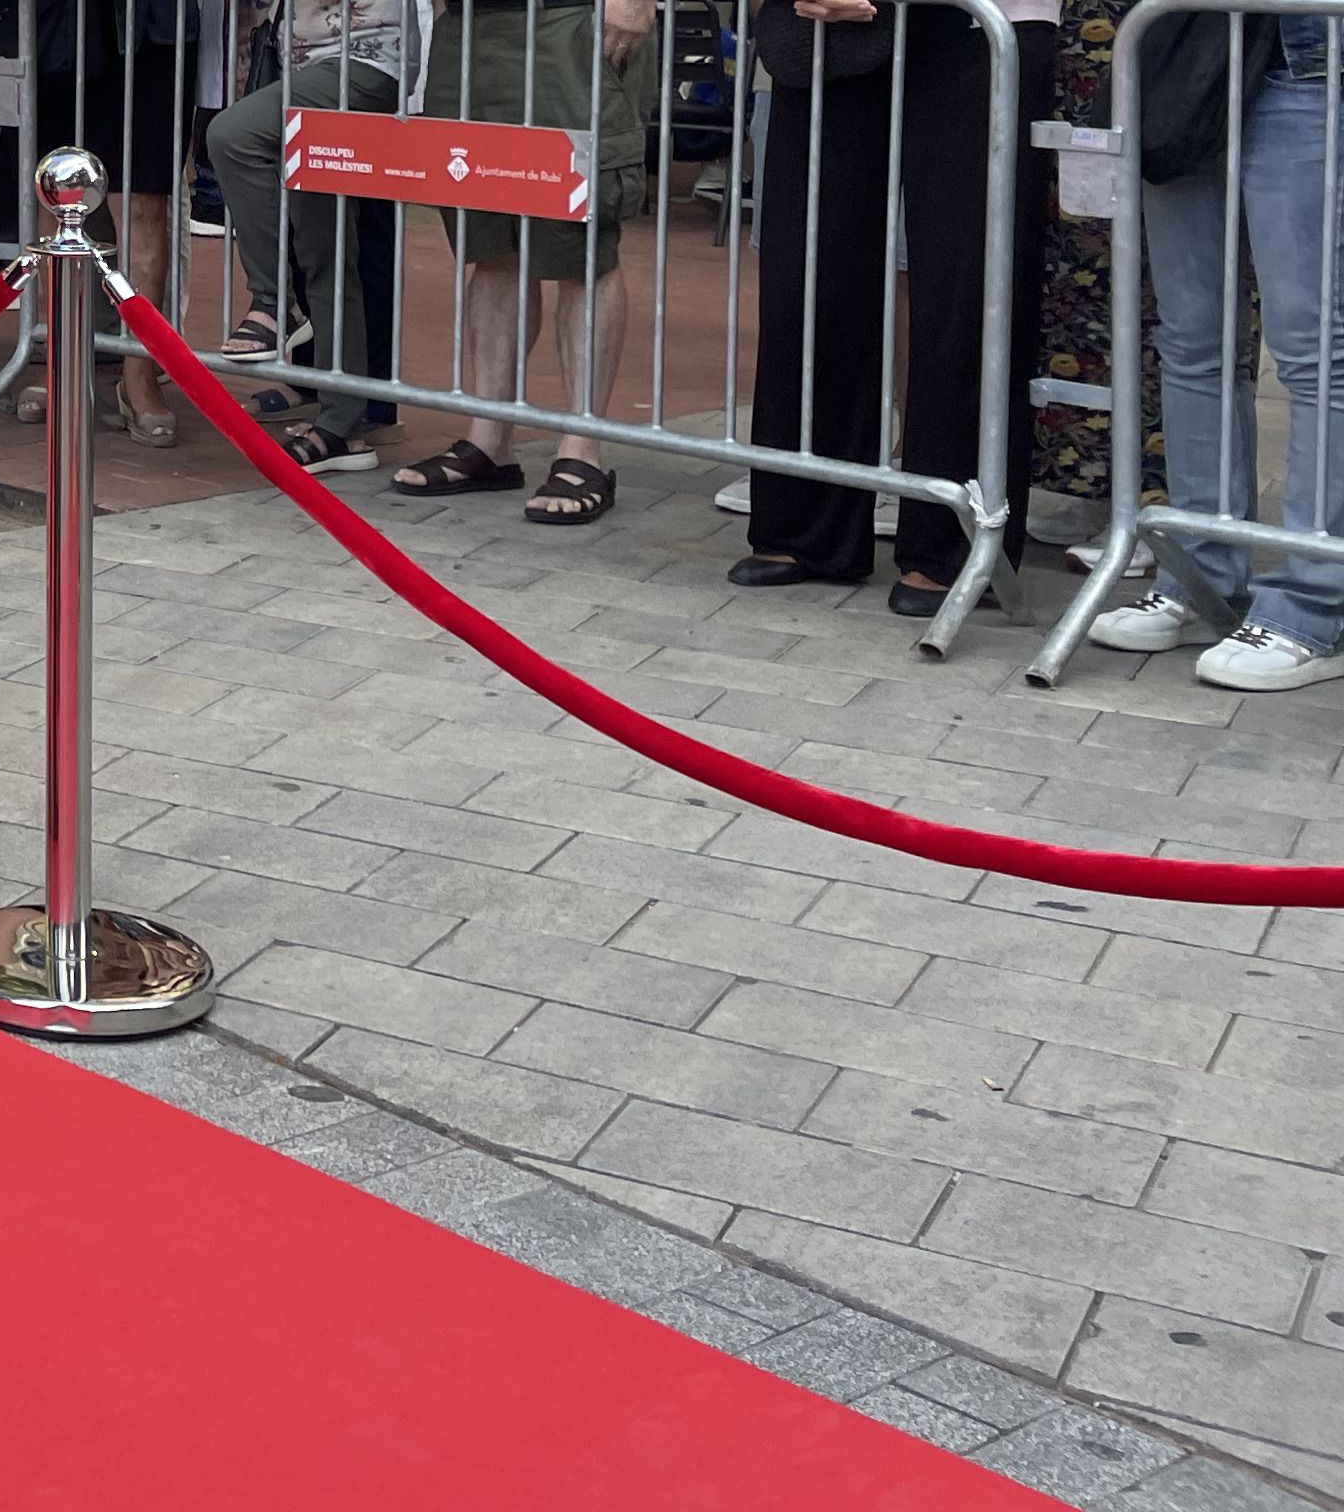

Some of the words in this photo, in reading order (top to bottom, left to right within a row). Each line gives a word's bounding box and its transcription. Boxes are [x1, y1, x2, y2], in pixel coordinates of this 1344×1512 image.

[308, 145, 355, 158] DISCULPEU
[308, 159, 323, 169] LES
[324, 159, 373, 174] MOLÈSTIES!
[475, 164, 526, 180] Ajuntament
[527, 170, 539, 181] de
